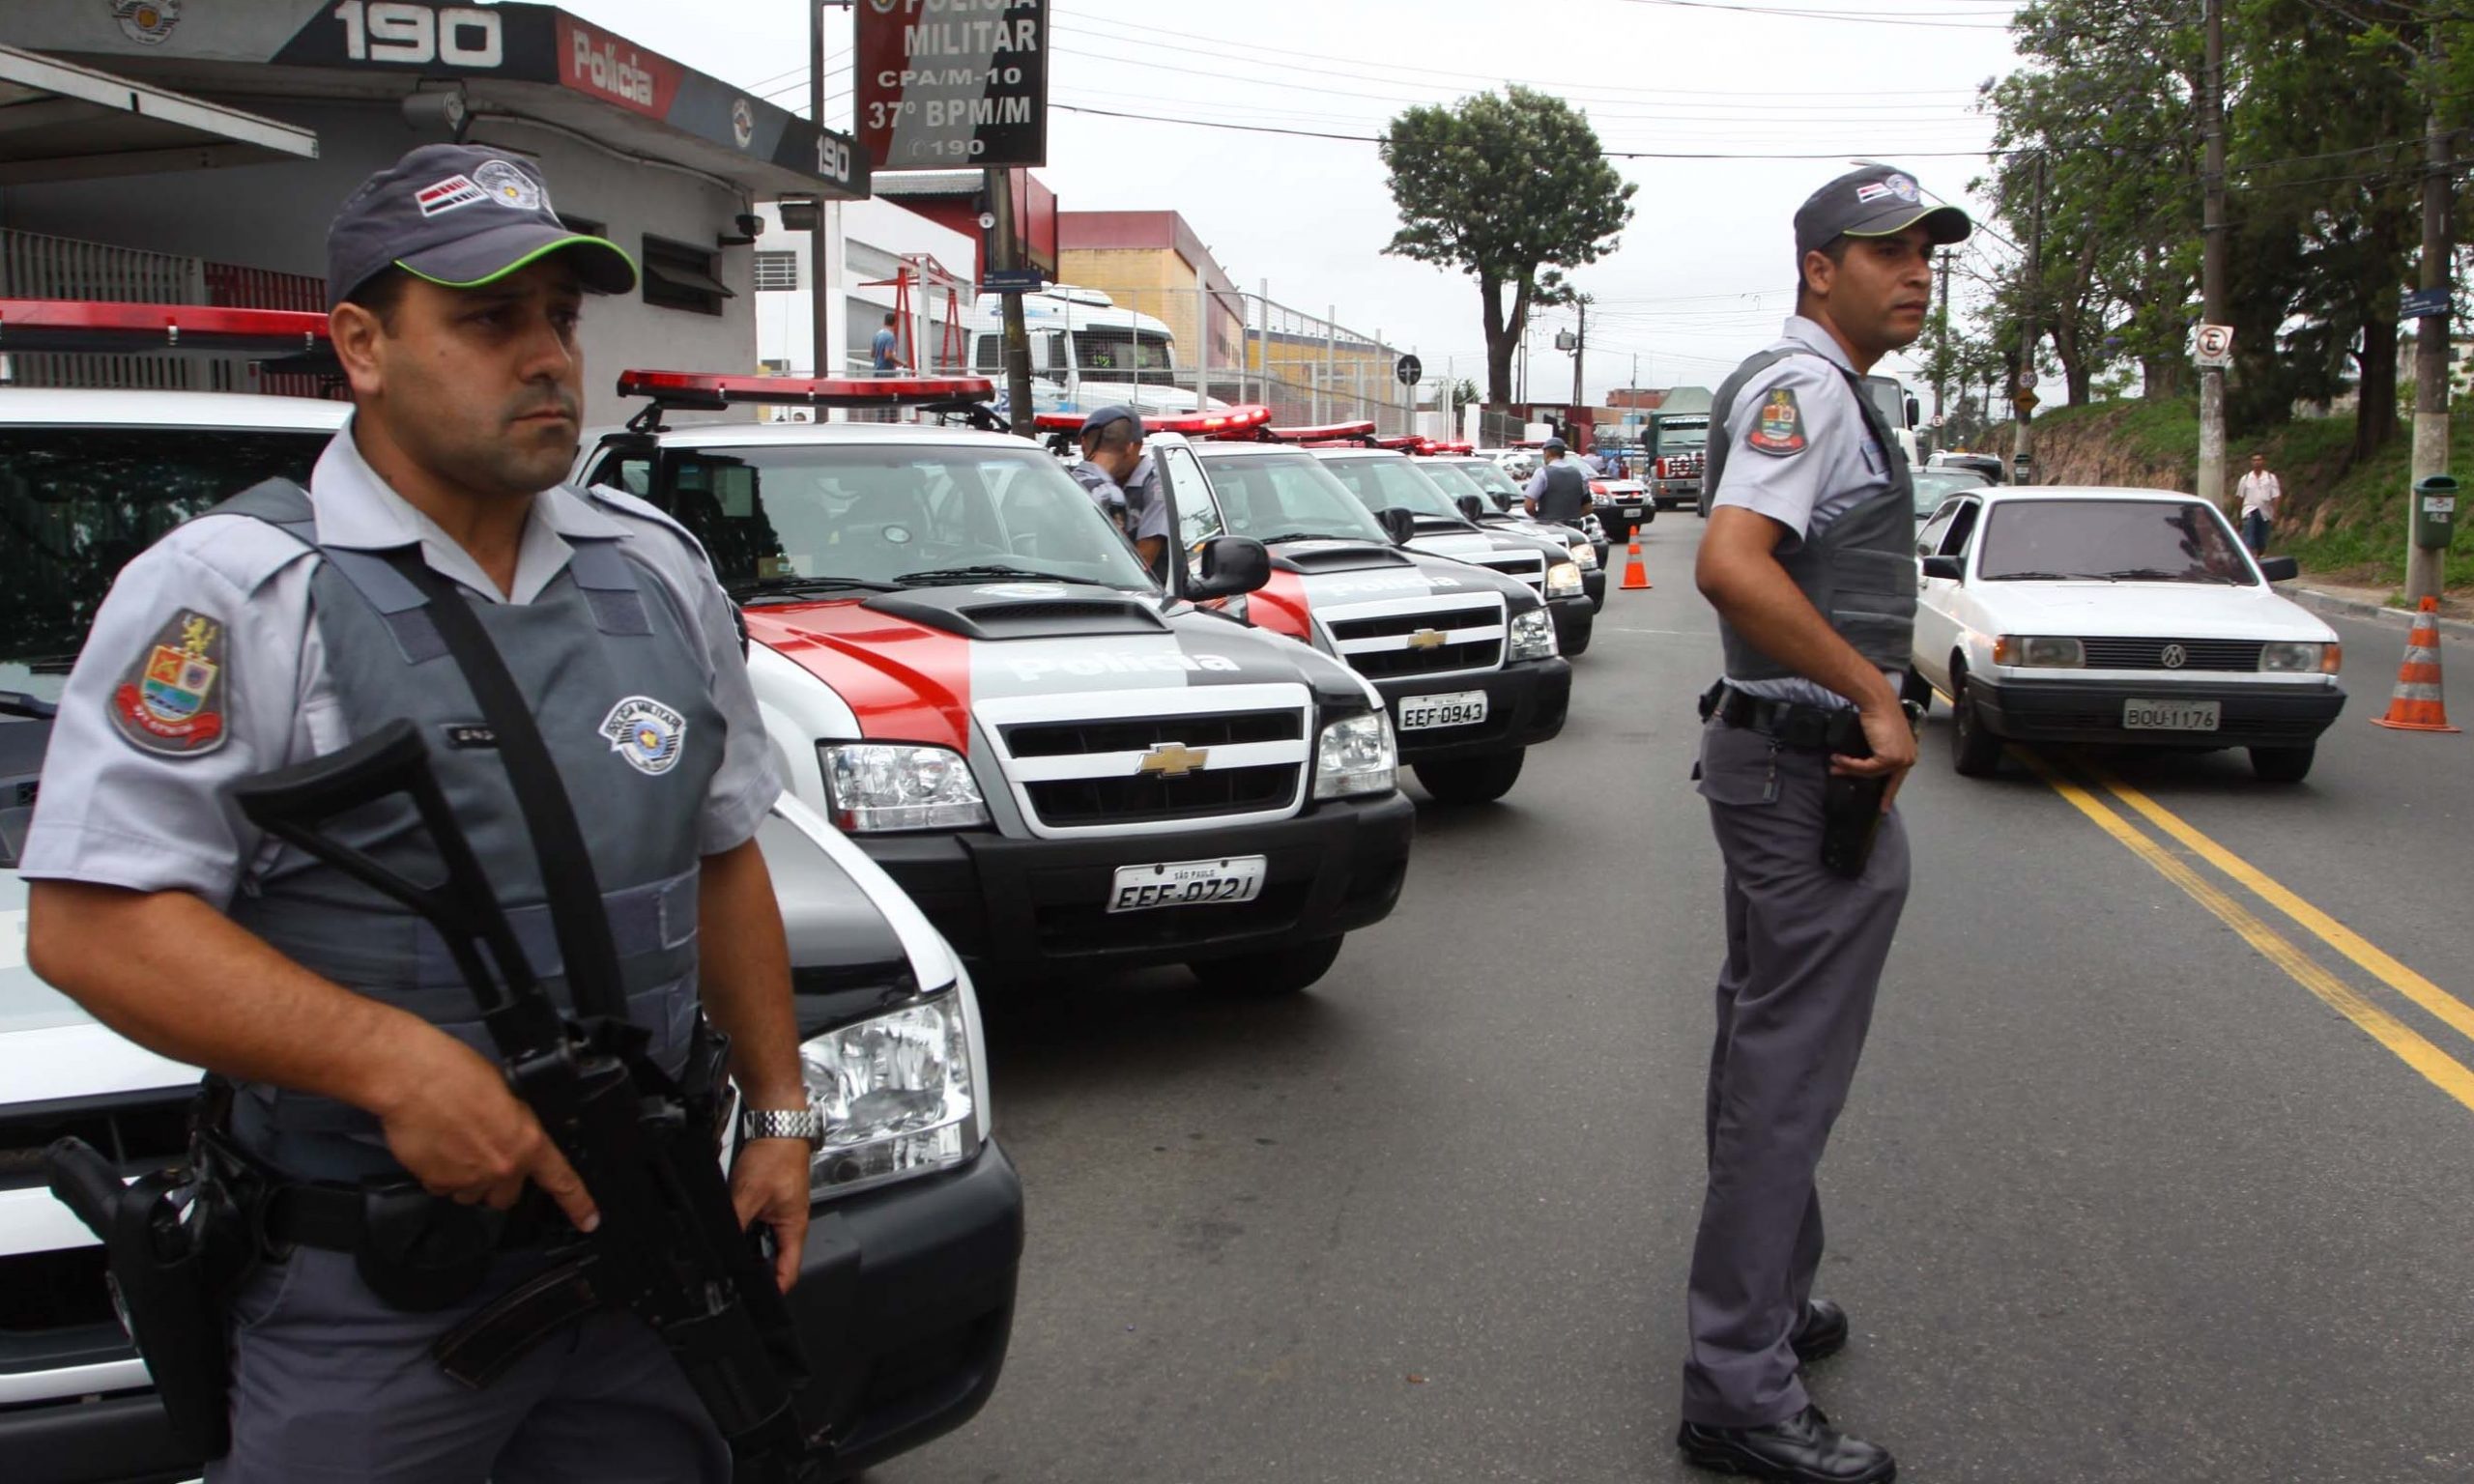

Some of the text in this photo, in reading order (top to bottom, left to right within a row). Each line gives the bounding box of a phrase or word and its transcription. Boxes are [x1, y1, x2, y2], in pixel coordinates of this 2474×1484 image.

[334, 1, 503, 69] 190
[905, 19, 1036, 57] MILITAR
[877, 68, 1022, 88] CPA/M-10
[926, 96, 1031, 127] BPM/M
[817, 134, 849, 183] 190
[931, 139, 986, 156] 190
